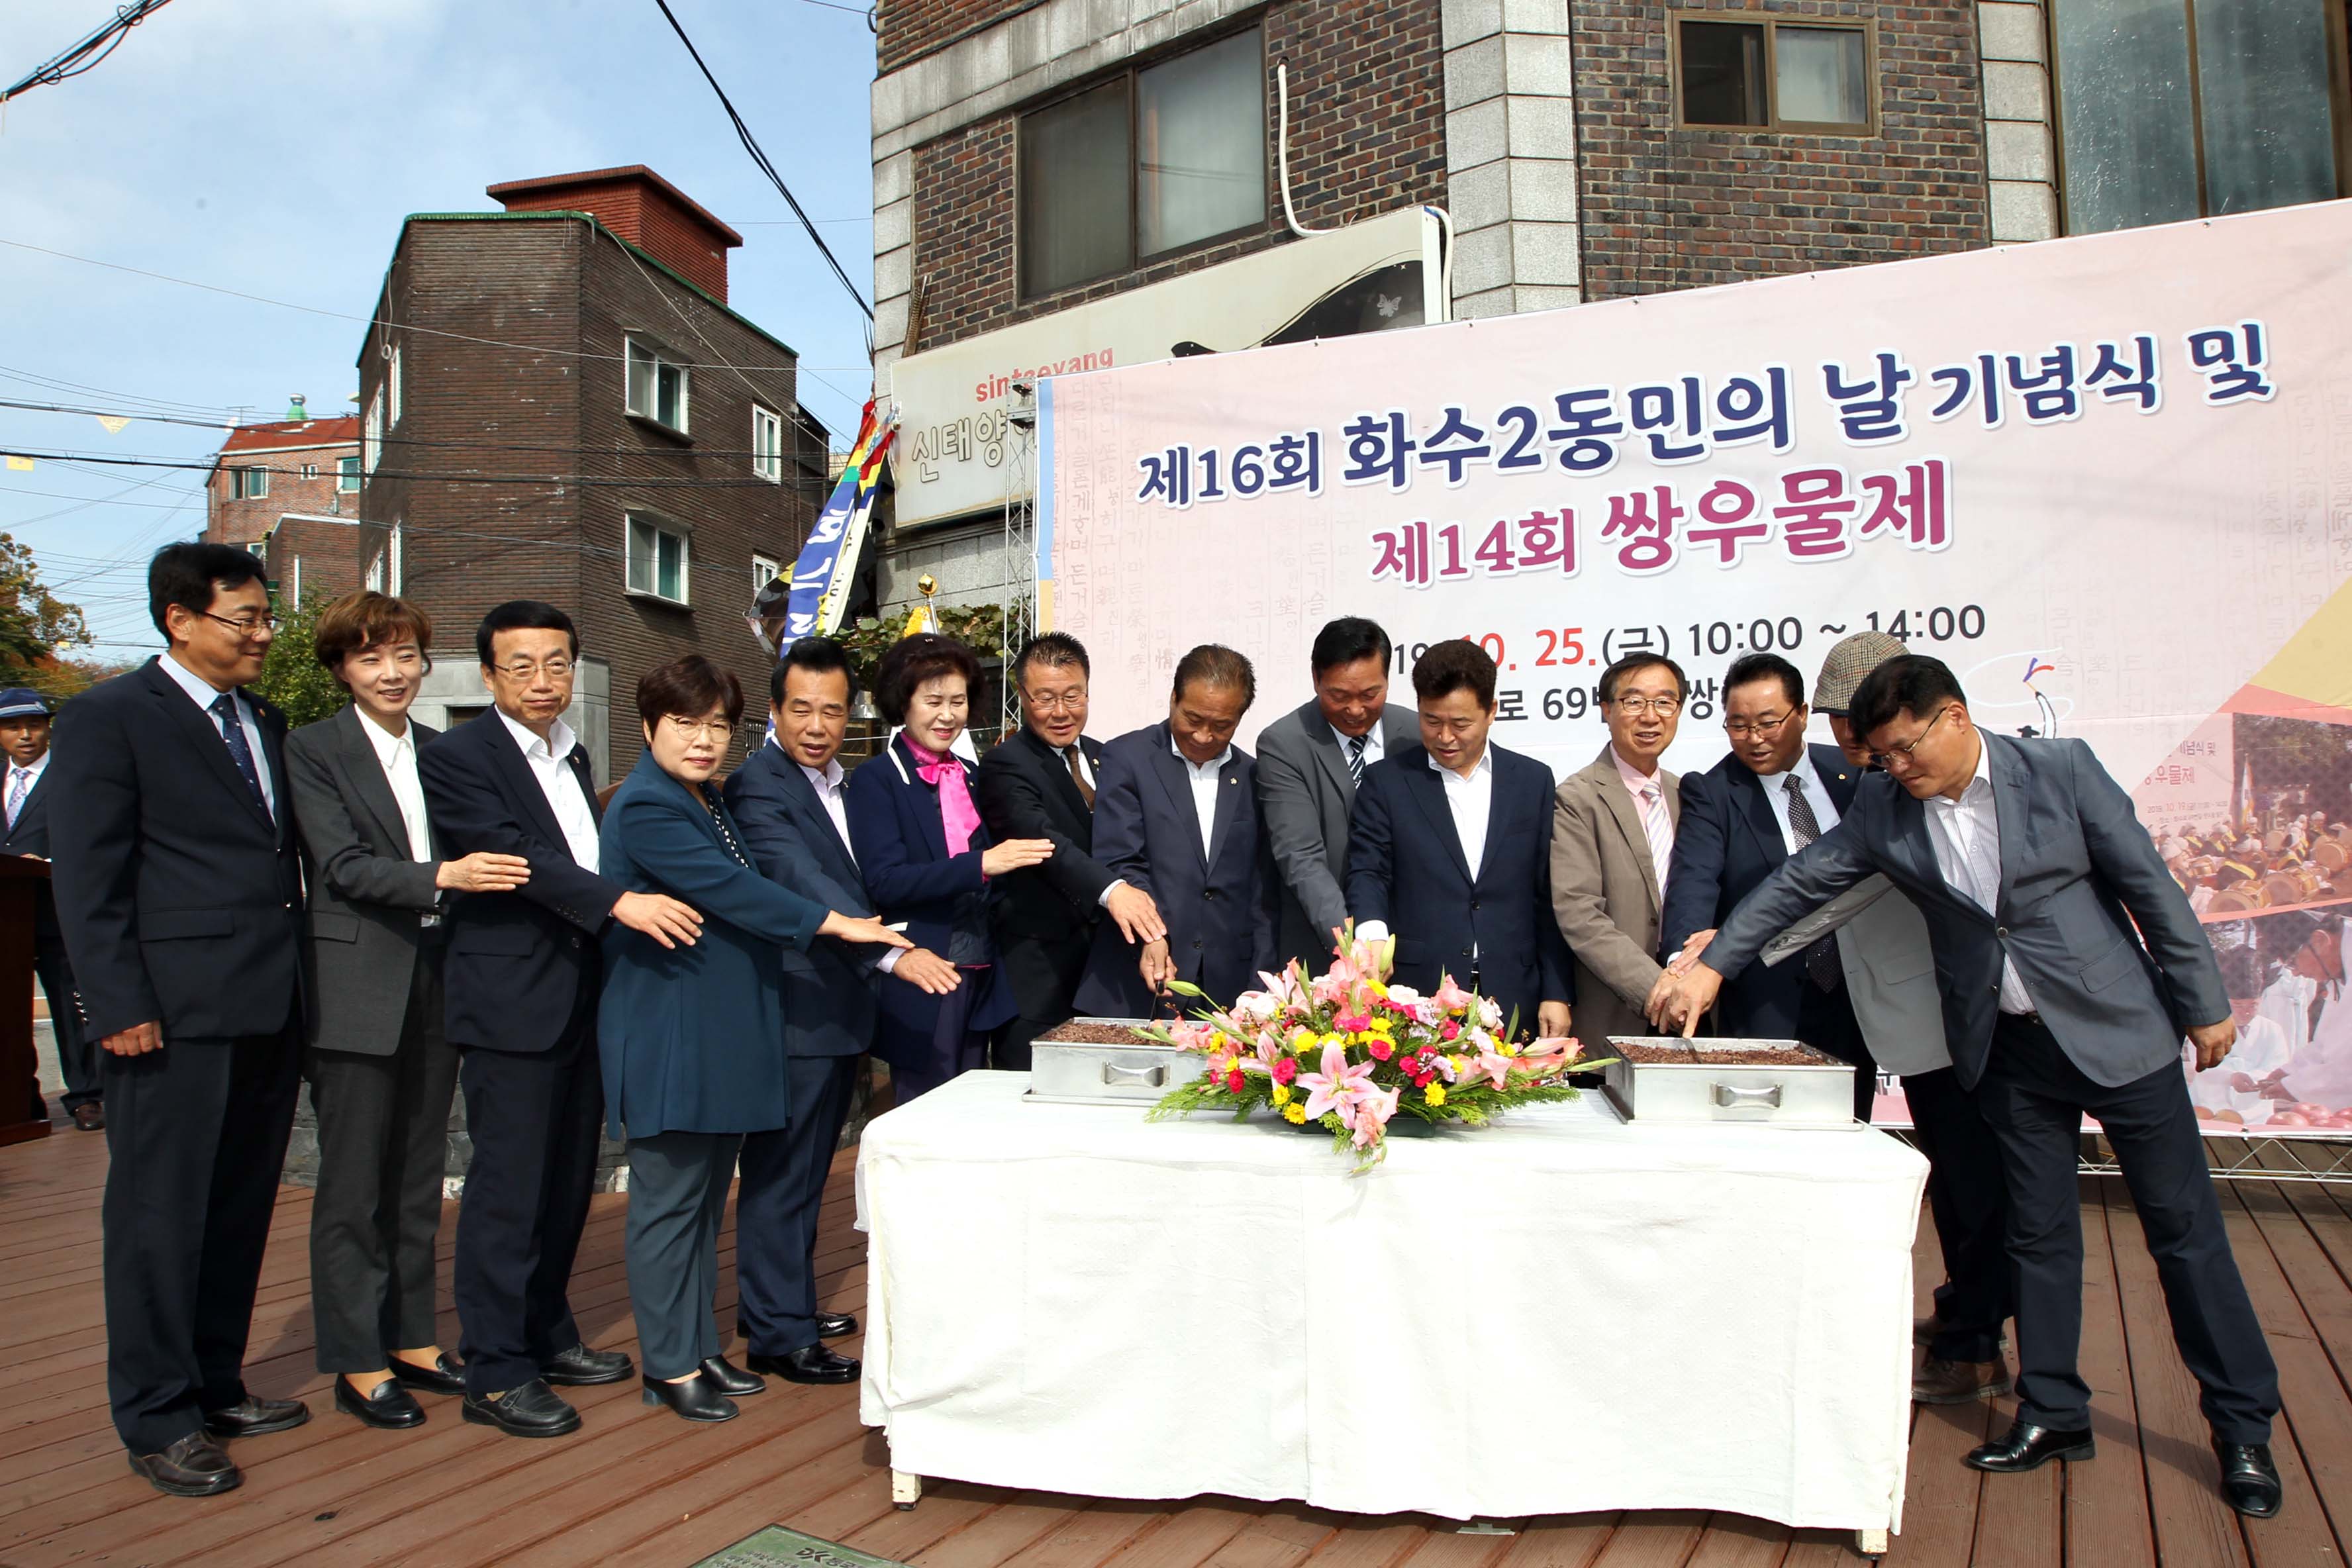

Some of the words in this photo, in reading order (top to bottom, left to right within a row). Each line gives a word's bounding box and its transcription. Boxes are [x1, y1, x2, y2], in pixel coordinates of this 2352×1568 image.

[1138, 431, 1322, 505] 제16회
[1343, 367, 1789, 487] 화수2동민의
[1822, 352, 1912, 440] 날
[1931, 336, 2156, 424] 기념식
[2188, 323, 2271, 400] 및
[1373, 508, 1575, 584] 제14회
[1601, 460, 1945, 572] 쌍우물제
[1462, 632, 1516, 670] 0.
[1689, 616, 1802, 656] 10:00
[1866, 605, 1985, 643] 14:00
